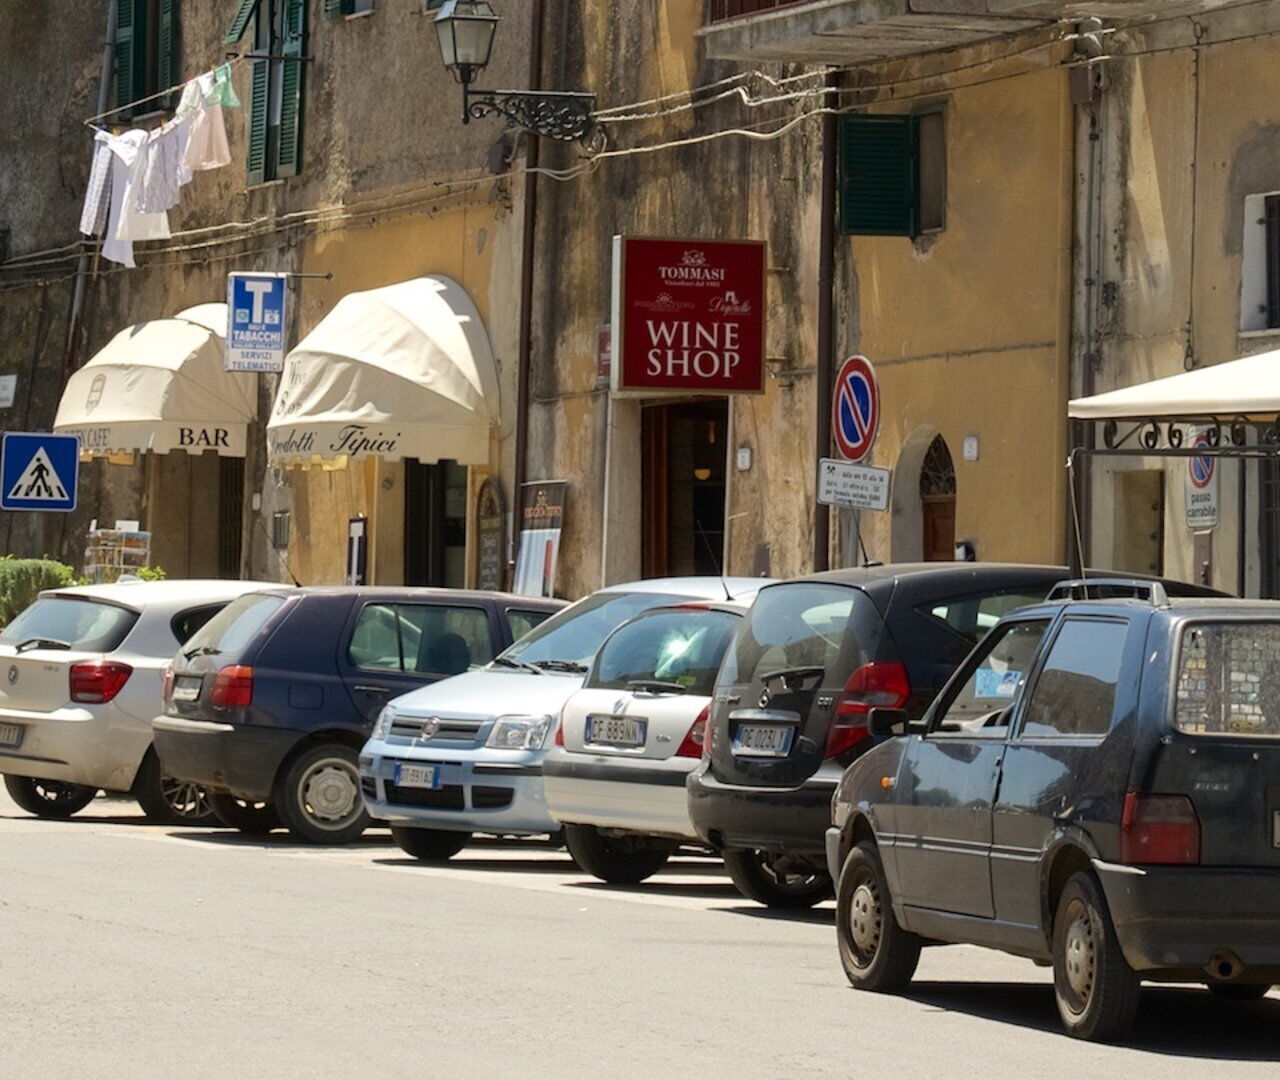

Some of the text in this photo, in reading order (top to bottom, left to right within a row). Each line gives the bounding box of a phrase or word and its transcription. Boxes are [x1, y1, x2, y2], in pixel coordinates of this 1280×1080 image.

[658, 266, 725, 281] TOMMASI
[245, 281, 272, 324] T
[233, 331, 281, 342] TABACCHI
[646, 320, 740, 350] WINE
[240, 352, 272, 360] SERVIZI
[647, 348, 740, 378] SHOP
[232, 361, 280, 371] TELEMATICI
[178, 427, 230, 447] BAR
[329, 424, 401, 456] Tipici
[1191, 493, 1211, 505] passo
[1187, 506, 1216, 518] carrabile
